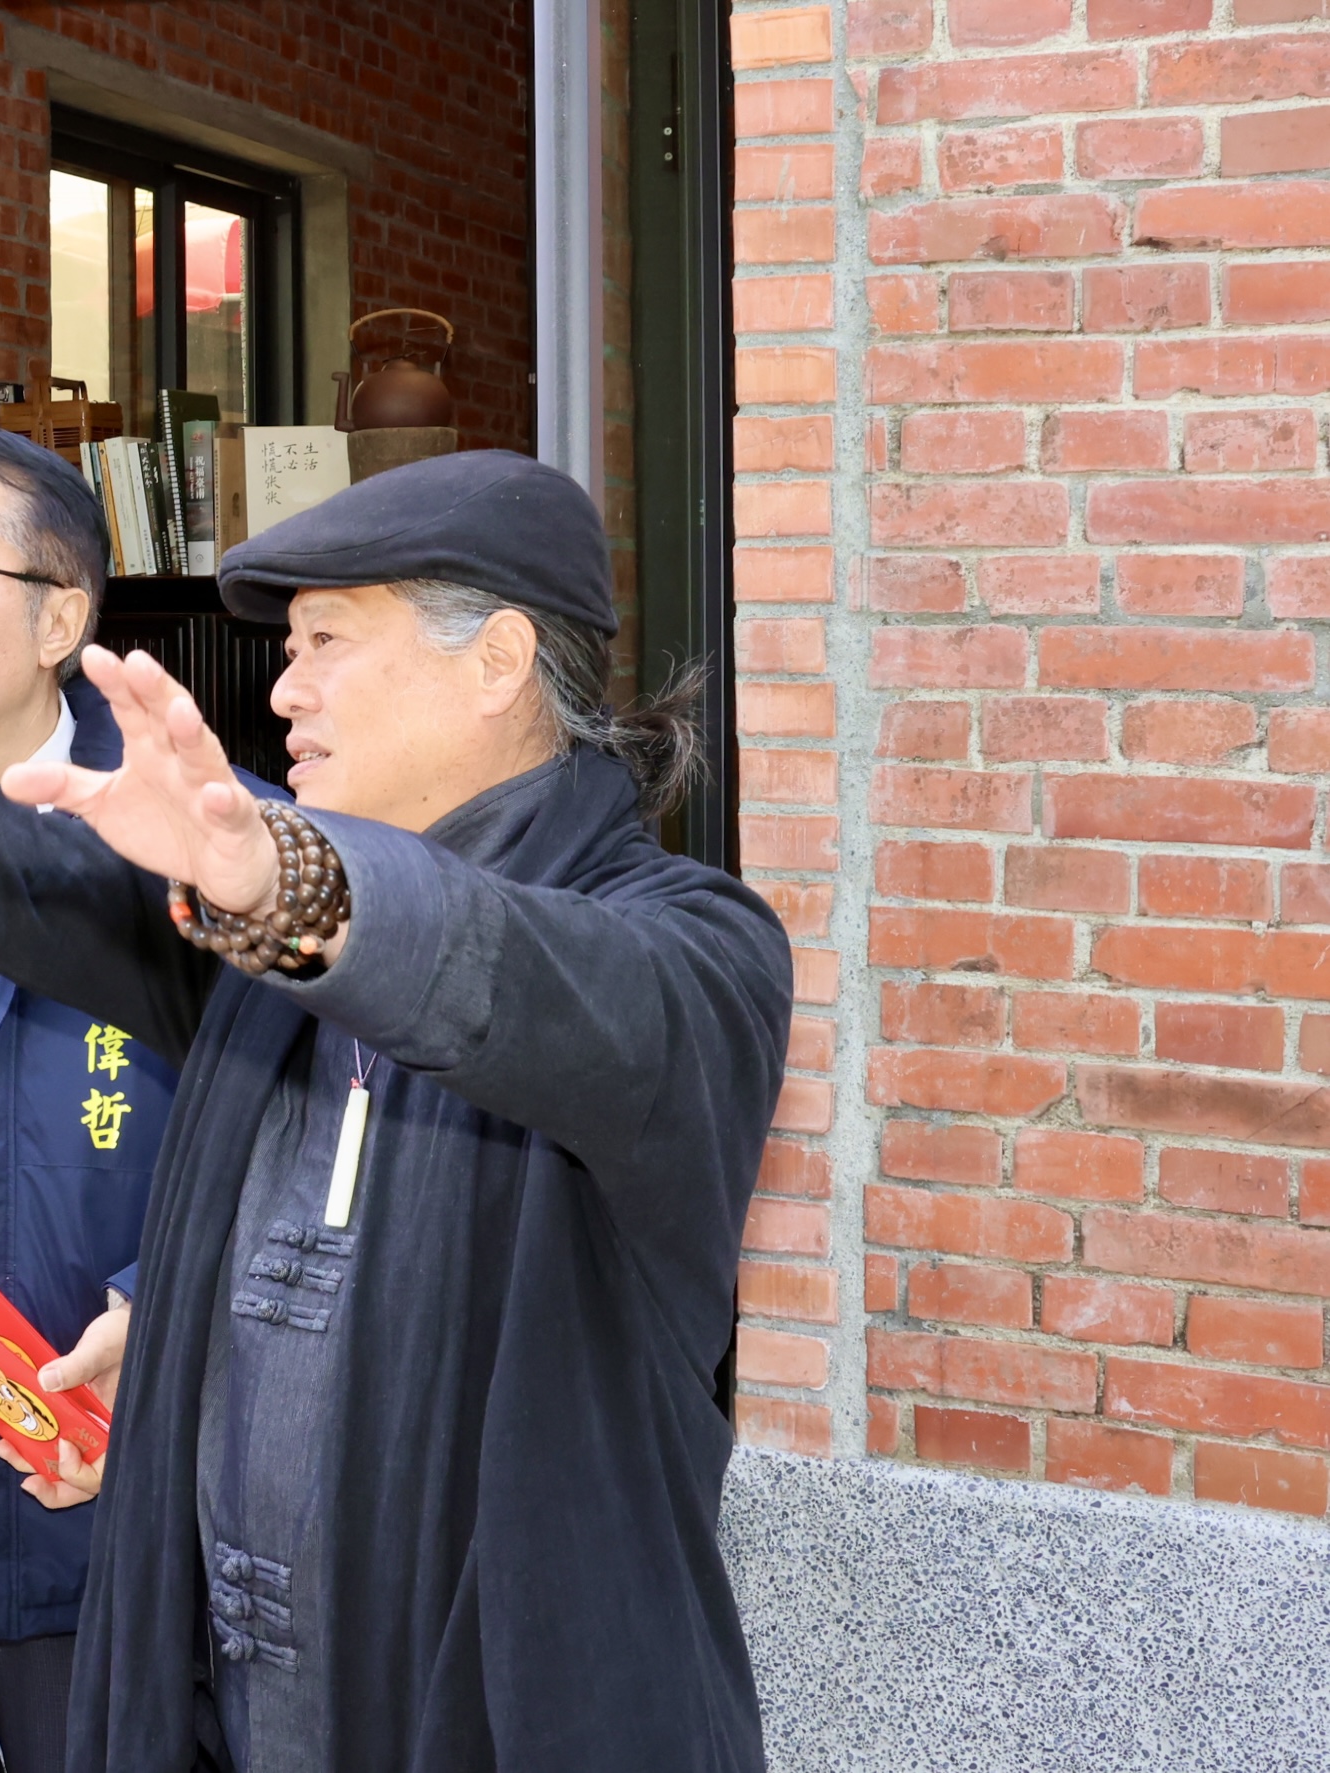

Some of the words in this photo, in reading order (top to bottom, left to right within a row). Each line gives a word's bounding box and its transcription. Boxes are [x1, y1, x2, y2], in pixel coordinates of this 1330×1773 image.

[283, 443, 298, 470] 不必
[303, 442, 319, 471] 生活
[80, 1023, 133, 1150] 偉哲
